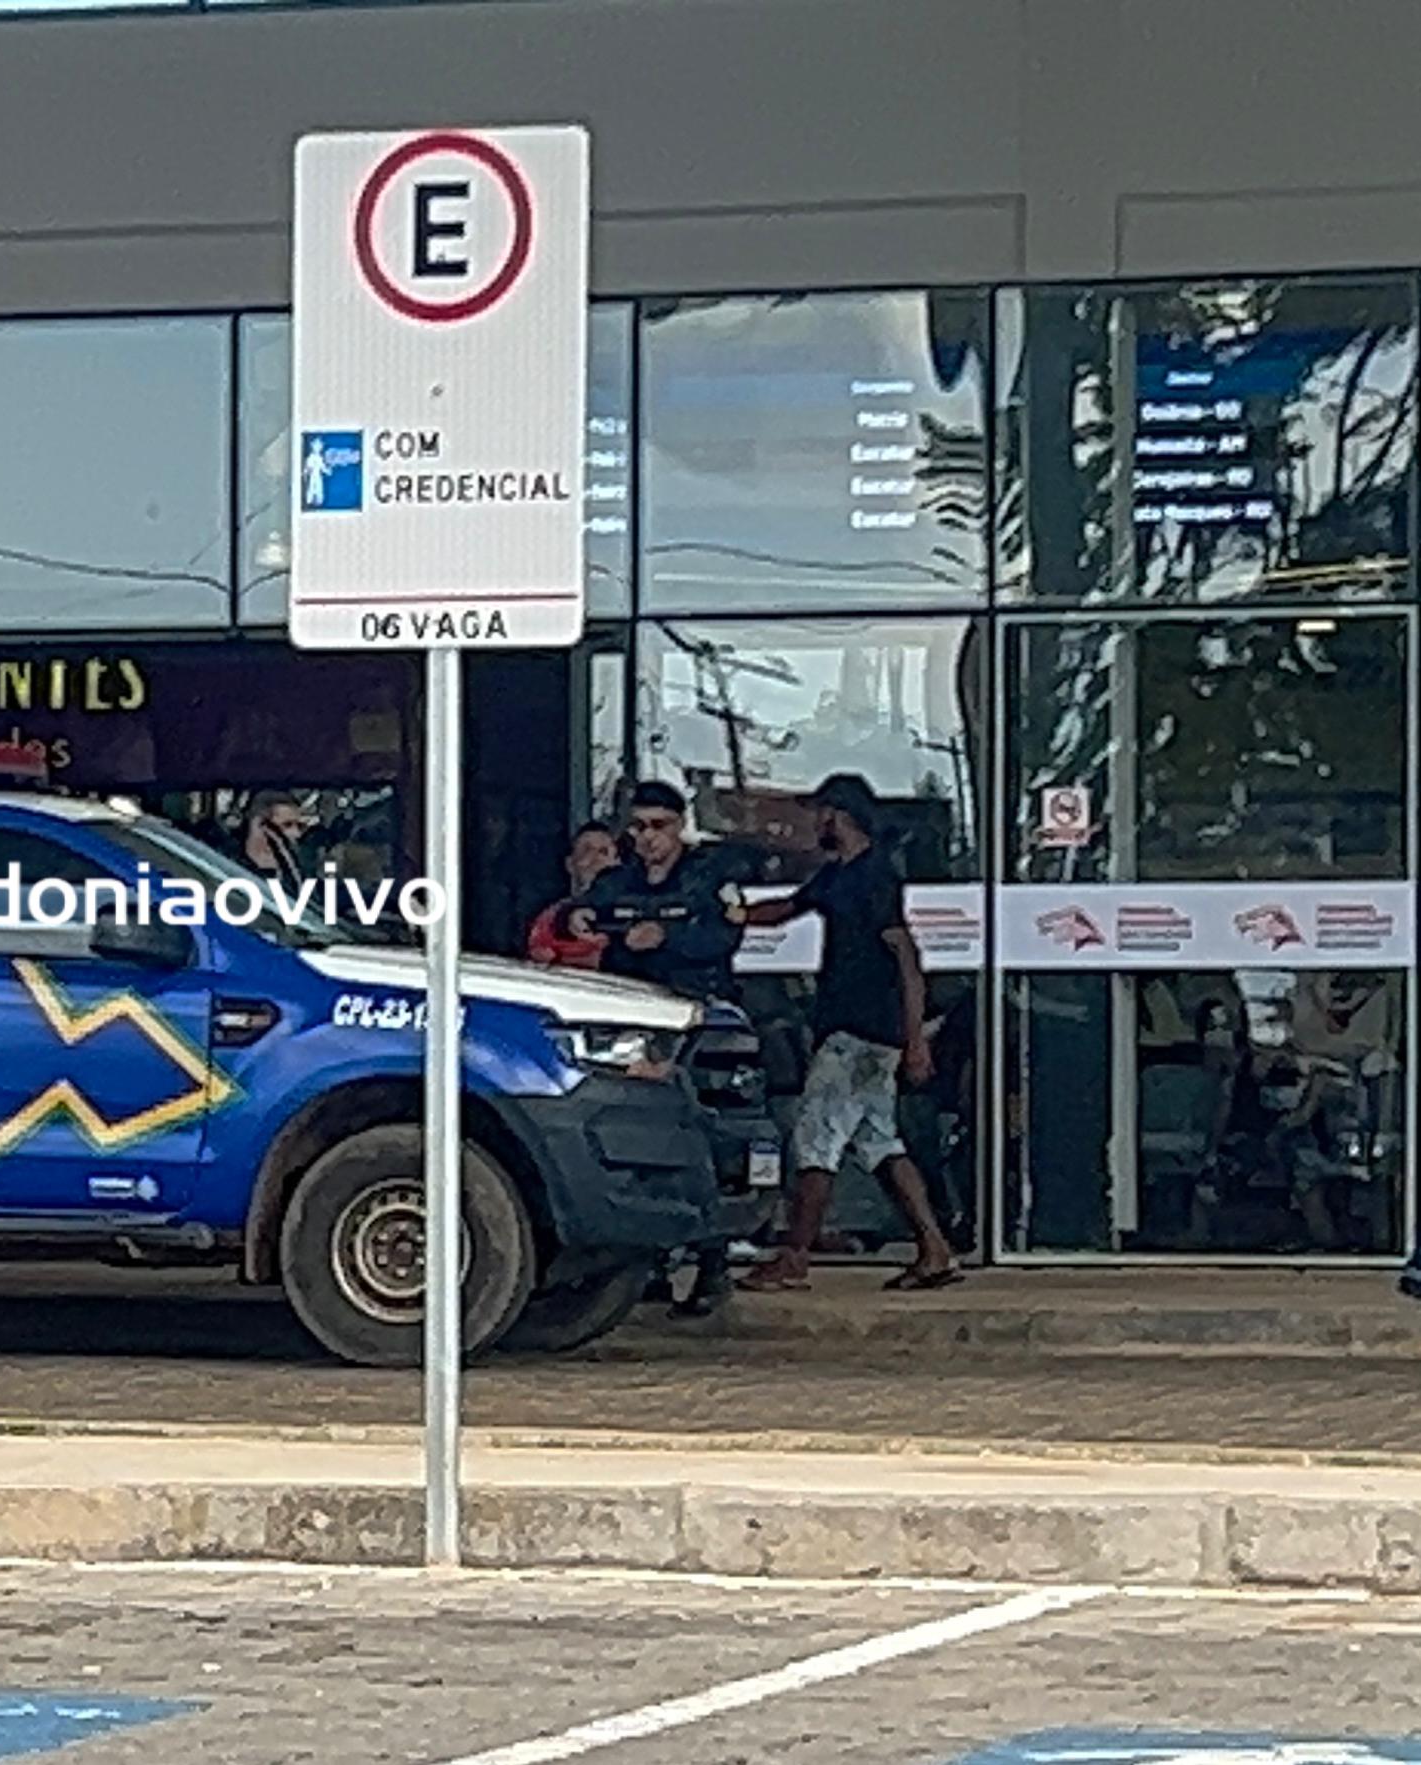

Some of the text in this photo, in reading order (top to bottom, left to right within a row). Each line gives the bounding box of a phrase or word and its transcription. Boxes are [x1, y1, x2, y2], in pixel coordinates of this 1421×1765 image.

[411, 181, 471, 278] E
[375, 432, 440, 459] COM
[374, 472, 571, 502] CREDENCIAL
[361, 611, 508, 642] 06 VAGA
